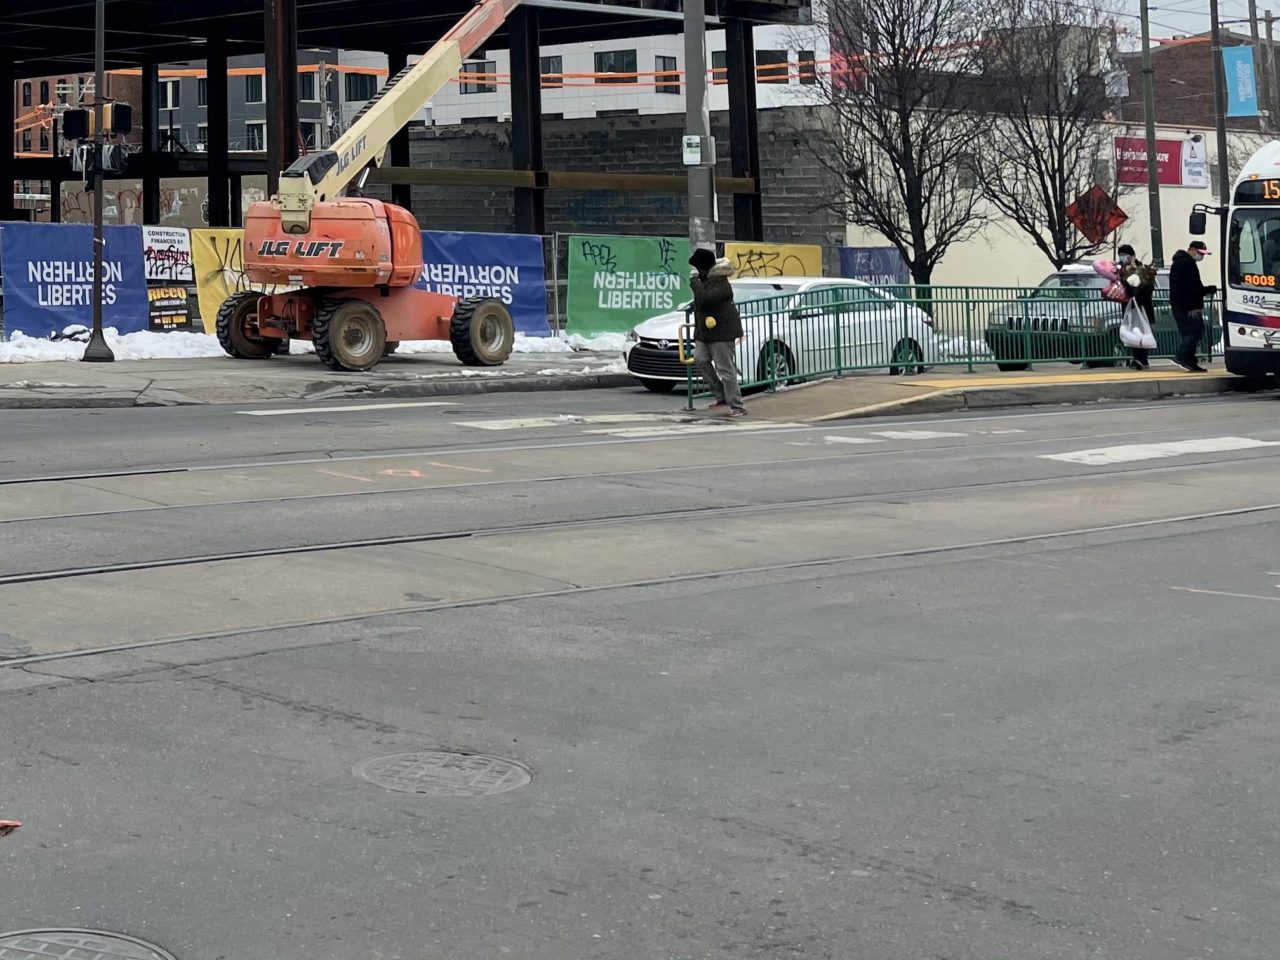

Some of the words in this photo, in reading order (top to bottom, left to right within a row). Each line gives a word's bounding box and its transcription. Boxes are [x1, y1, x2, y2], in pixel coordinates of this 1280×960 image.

[351, 135, 367, 161] LIFT
[148, 230, 186, 238] CONSTRUCTION
[258, 241, 290, 257] JLG
[294, 241, 344, 259] LIFT
[28, 261, 122, 282] NORTHERN
[418, 264, 520, 285] NORTHERN
[593, 272, 680, 289] NORTHERN
[1244, 274, 1276, 286] 9008
[148, 287, 187, 302] RICCO
[598, 291, 673, 309] LIBERTIES
